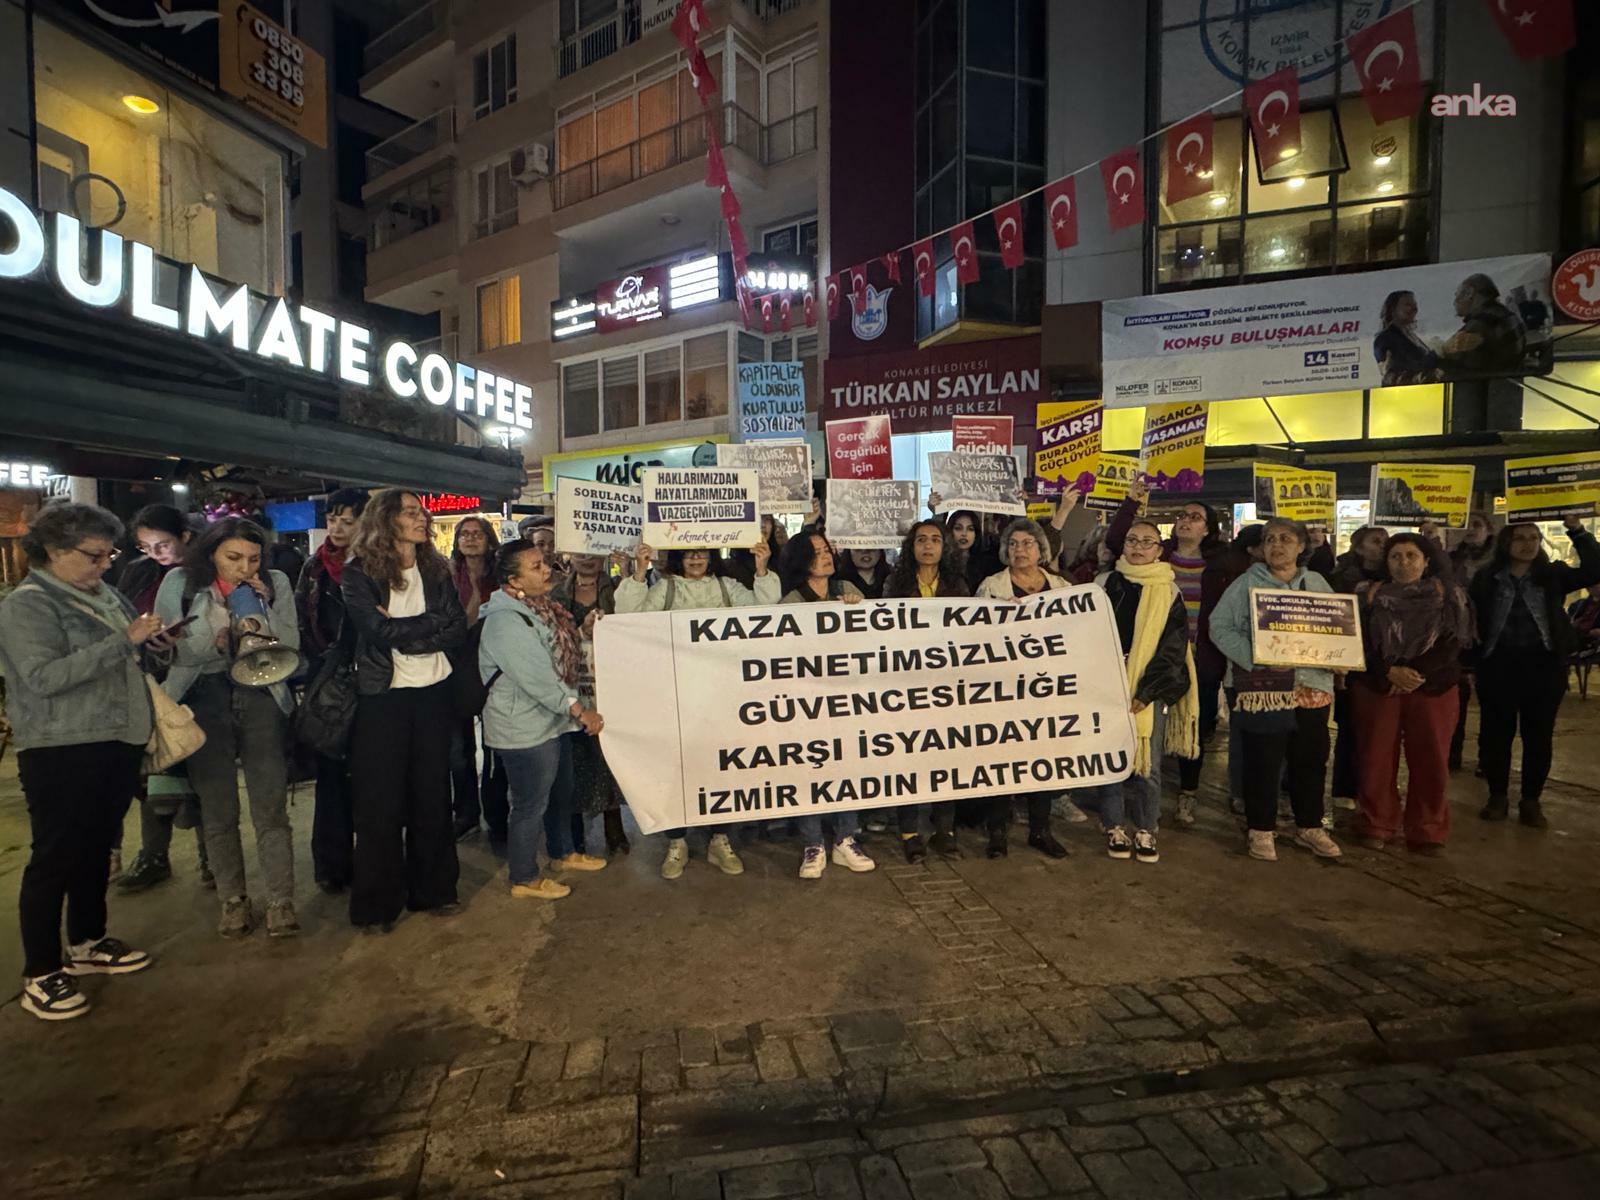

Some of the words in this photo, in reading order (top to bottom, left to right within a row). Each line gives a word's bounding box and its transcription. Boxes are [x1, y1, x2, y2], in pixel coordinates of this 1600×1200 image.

[254, 18, 304, 65] 0850
[268, 49, 304, 87] 308
[1564, 252, 1600, 273] LOUIS
[1163, 334, 1224, 351] KOMŞU
[1230, 320, 1360, 344] BULUŞMALARI
[1305, 352, 1327, 365] 14
[884, 367, 921, 379] KONAK
[385, 341, 533, 429] COFFEE
[830, 380, 930, 408] TÜRKAN
[936, 368, 1040, 399] SAYLAN
[870, 404, 927, 420] KÜLTÜR
[1147, 403, 1203, 428] İNSANCA
[837, 431, 880, 443] Gerçek
[1042, 412, 1099, 445] KARŞI
[1144, 418, 1206, 445] YAŞAMAK
[834, 444, 888, 461] Özgürlük
[1039, 433, 1099, 461] BURADAYIZ
[1040, 444, 1100, 472] GÜÇLÜYÜZ!
[658, 472, 739, 486] HAKLARIMIZDAN
[852, 463, 873, 476] için
[655, 487, 748, 501] HAYATLARIMIZDAN
[573, 510, 642, 526] KURULACA
[591, 500, 630, 513] HESAP
[660, 502, 744, 522] VAZGEÇMİYORUZ
[573, 521, 616, 534] YAŞAM
[618, 525, 642, 537] VAR
[678, 529, 711, 543] ekmek
[711, 532, 721, 542] ve
[723, 530, 742, 544] gül
[690, 613, 803, 642] KAZA
[816, 603, 930, 635] DEĞİL
[943, 592, 1096, 628] KATLİAM
[1268, 621, 1311, 633] ŞİDDETE
[1312, 624, 1343, 634] HAYIR
[742, 633, 1067, 682] DENETİMSİZLİĞE
[739, 671, 1077, 726] GÜVENCESİZLİĞE
[718, 738, 843, 771] KARŞI
[858, 713, 1081, 759] İSYANDAYIZ
[1092, 712, 1101, 734] !
[698, 781, 800, 816] İZMİR
[811, 773, 917, 804] KADIN
[930, 750, 1128, 792] PLATFORMU
